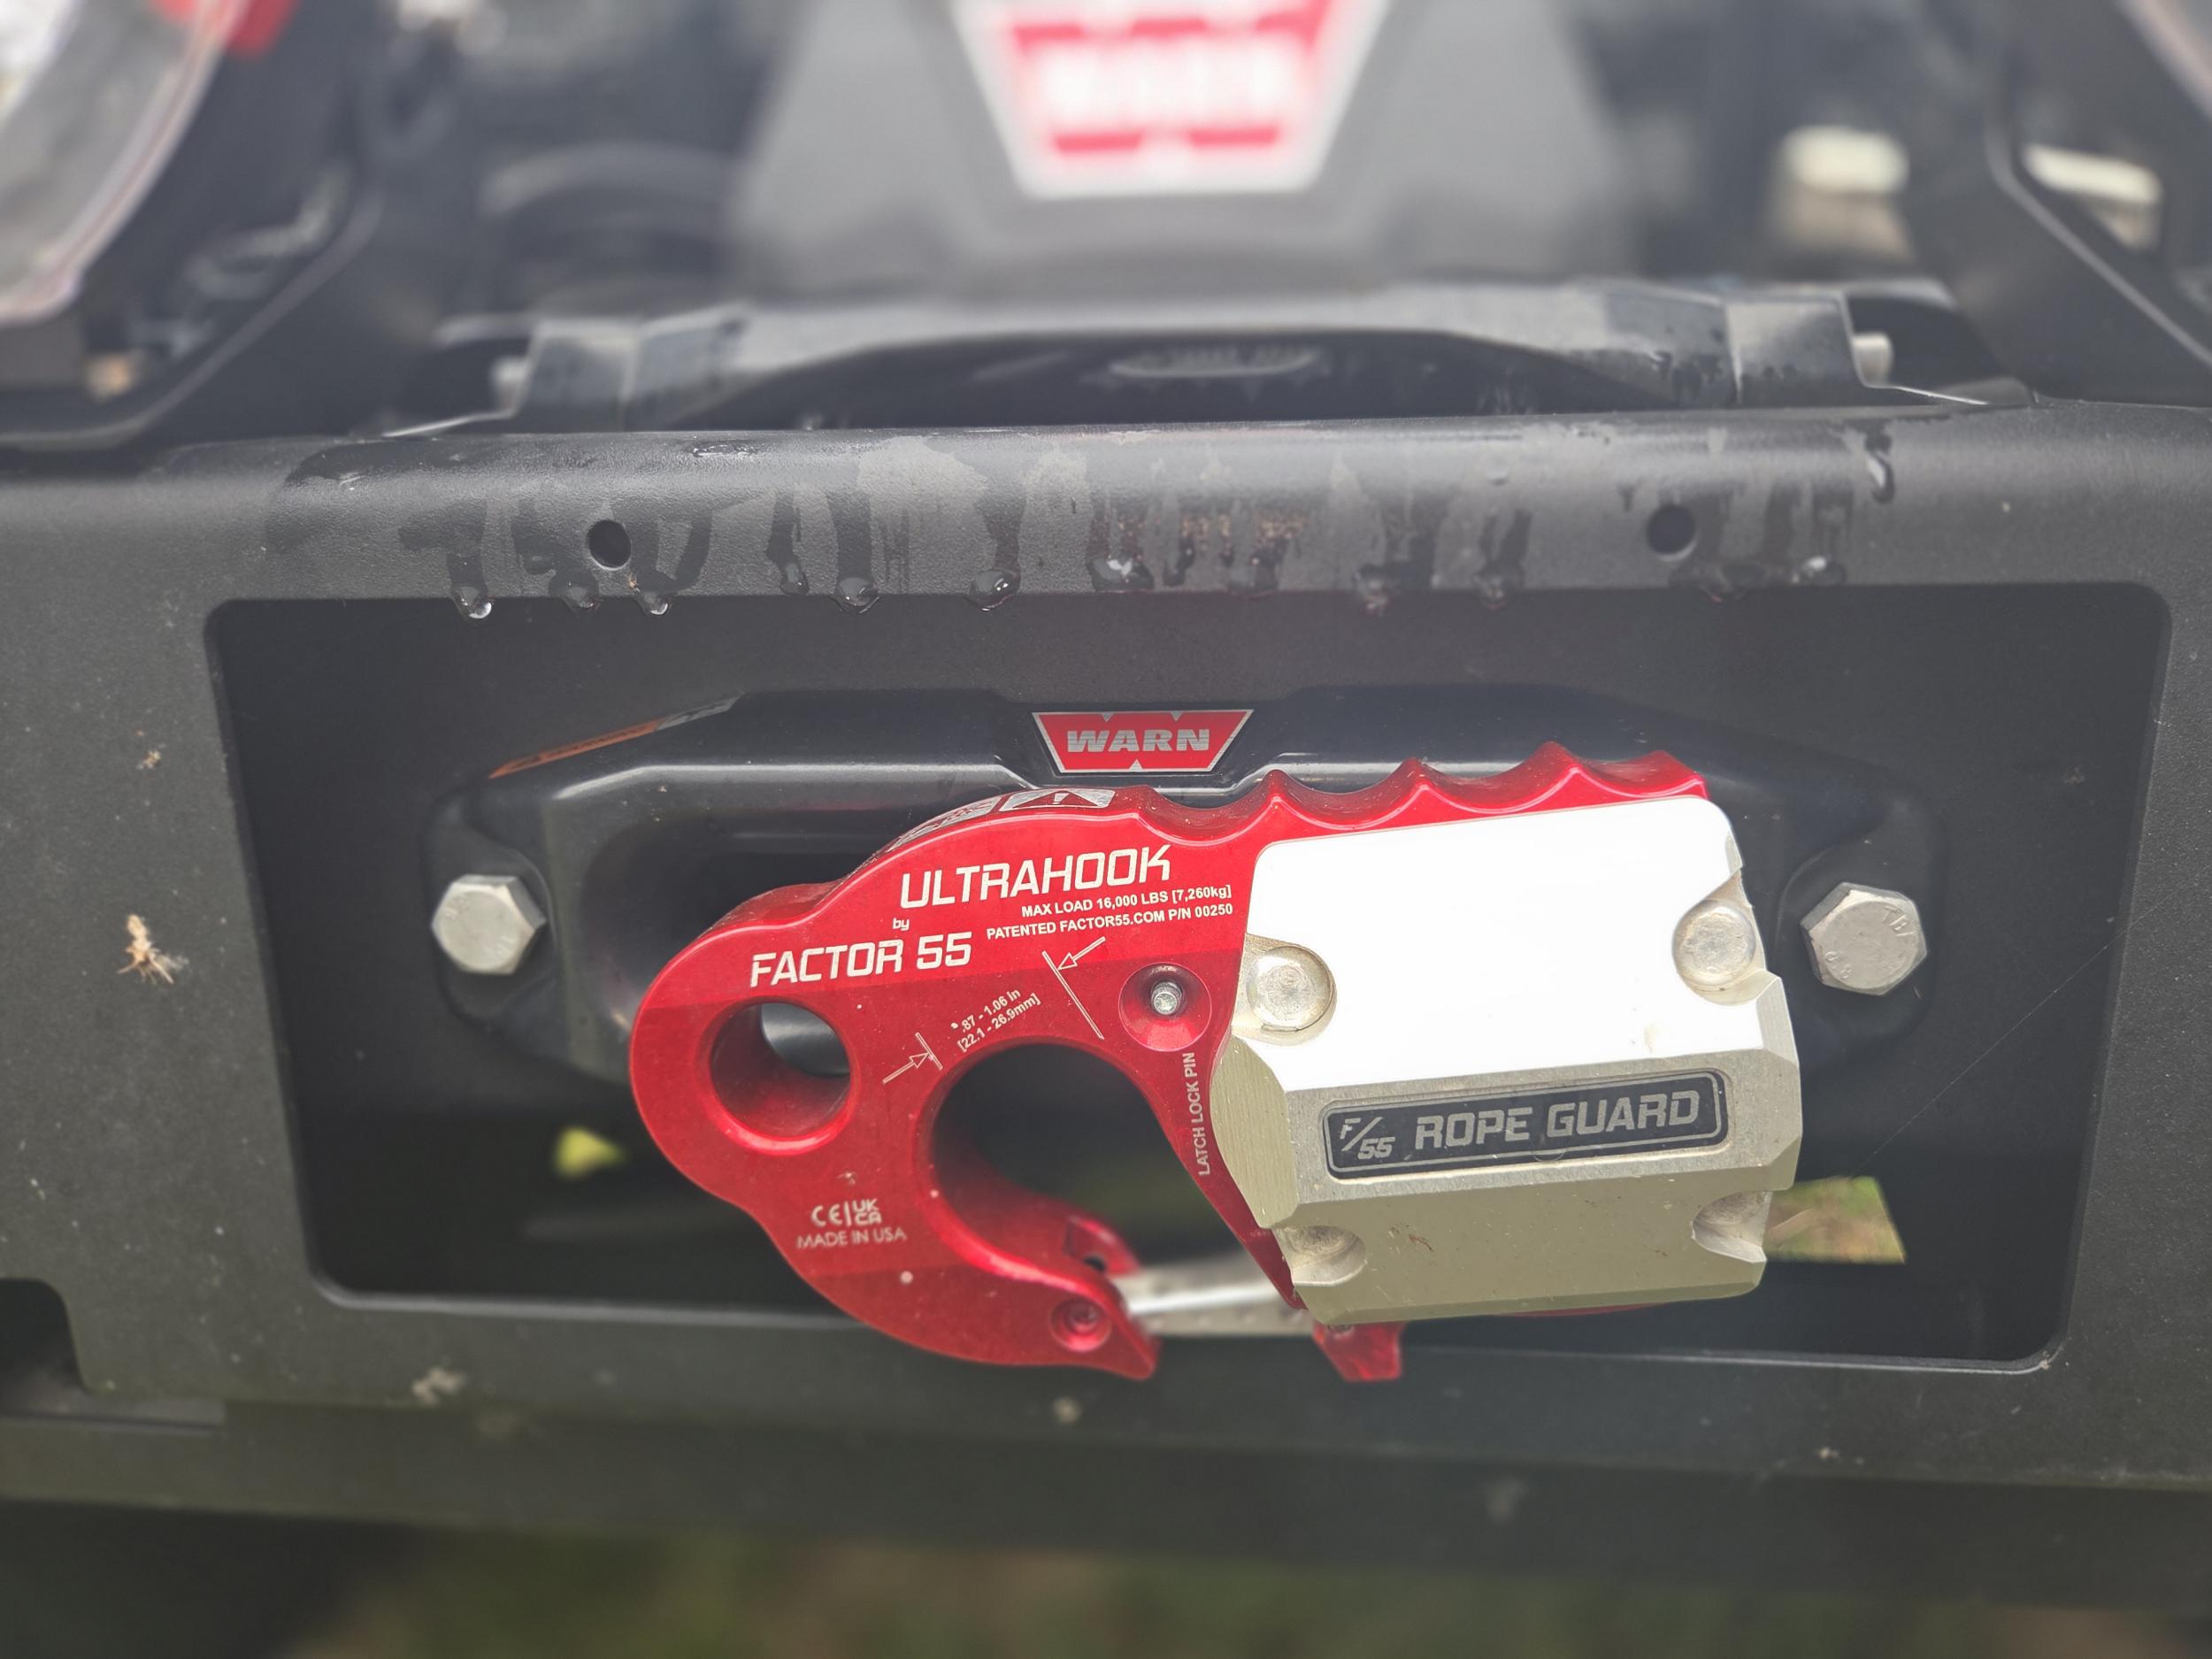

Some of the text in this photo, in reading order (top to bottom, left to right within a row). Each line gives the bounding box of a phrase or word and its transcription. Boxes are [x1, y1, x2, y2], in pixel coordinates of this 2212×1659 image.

[1067, 729, 1210, 752] WARN
[900, 844, 1171, 909] ULTRAHOOK
[1022, 885, 1232, 918] MAX LOAD 16,000 LBS [7,260kg]
[892, 918, 910, 932] by
[987, 902, 1233, 940] PATENTED FACTOR55.COM P/N 00250
[750, 931, 972, 987] FACTOR 55
[956, 1027, 986, 1053] [22.1
[991, 992, 1041, 1030] 26.9mm]
[984, 995, 1009, 1016] 1.06
[1182, 1052, 1211, 1176] LATCH LOCK PIN
[1415, 1107, 1533, 1150] ROPE
[1546, 1090, 1700, 1138] GUARD
[796, 1226, 908, 1248] MADE IN USA
